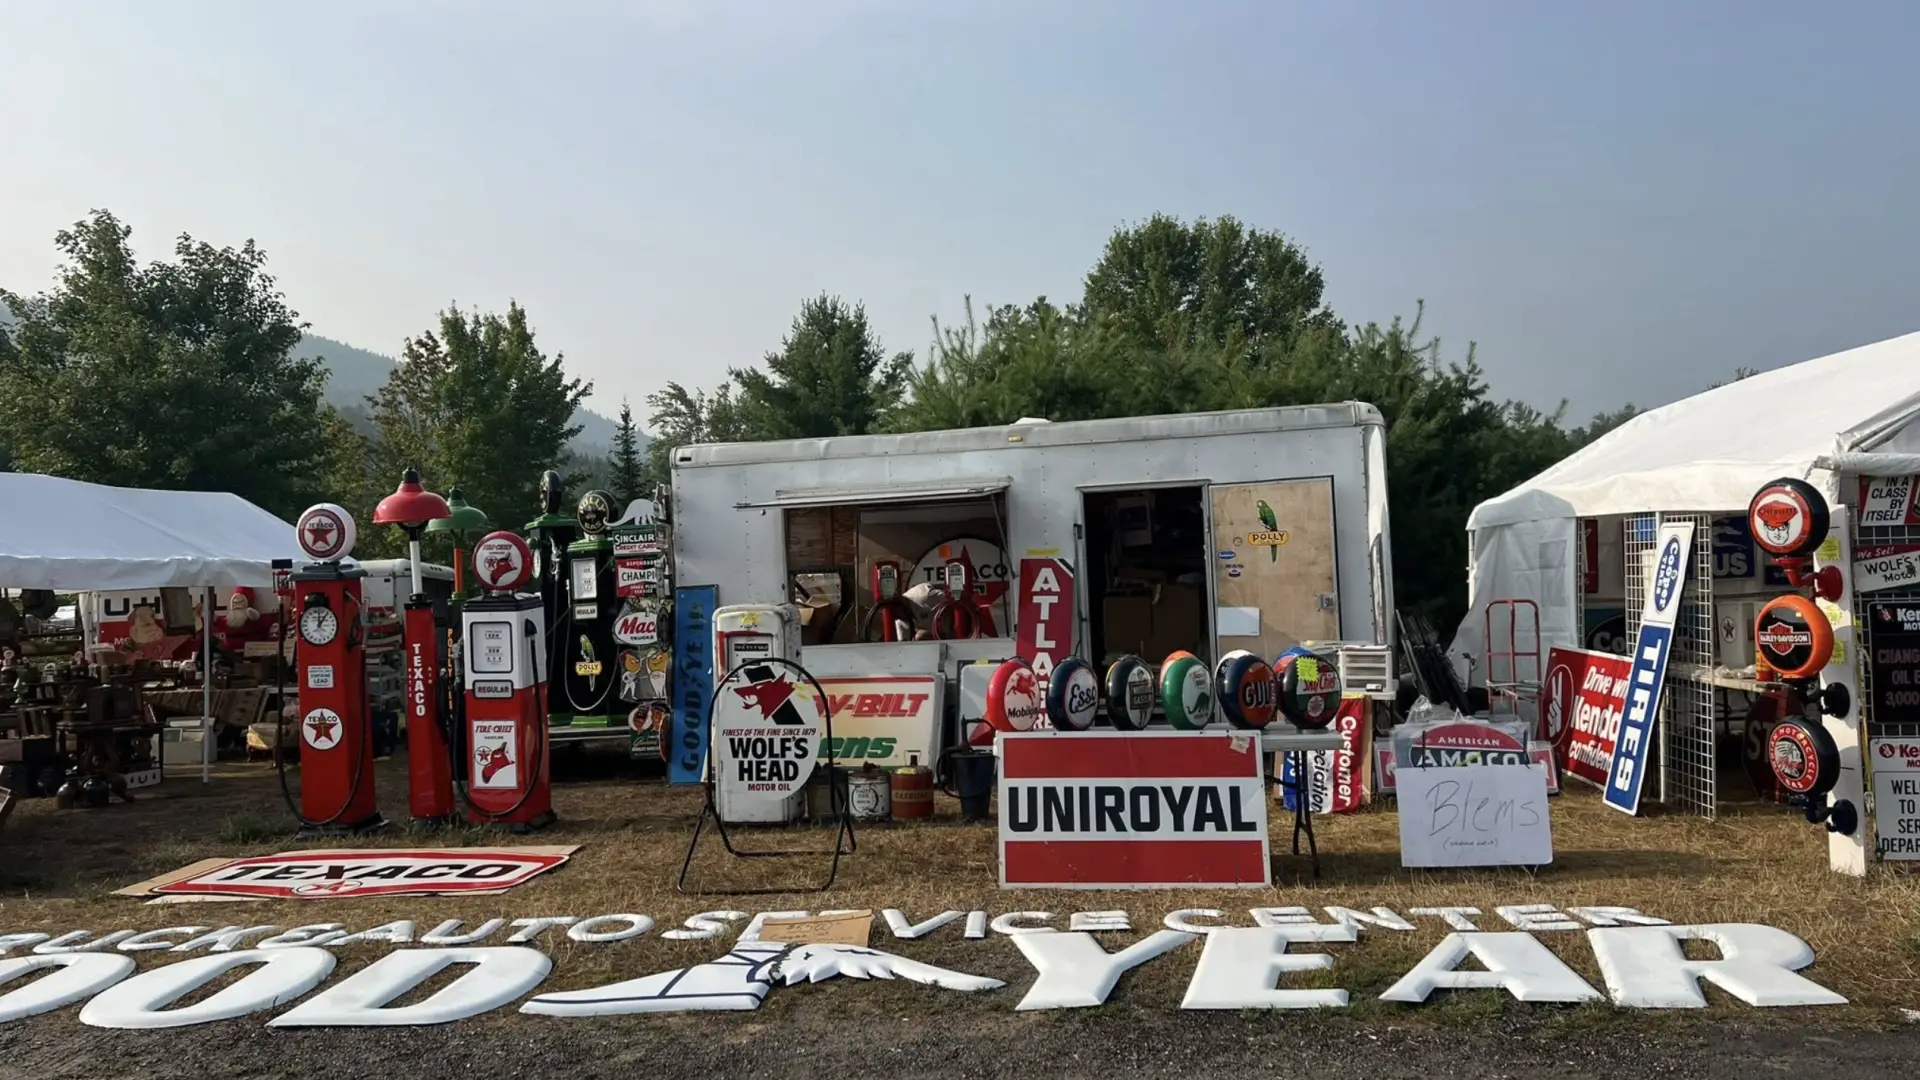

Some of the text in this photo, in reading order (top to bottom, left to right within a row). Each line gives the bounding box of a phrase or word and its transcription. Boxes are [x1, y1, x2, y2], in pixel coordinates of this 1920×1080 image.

[1871, 487, 1908, 499] CLASS
[1889, 499, 1905, 509] BY
[1866, 510, 1903, 520] ITSELF
[614, 533, 655, 545] SINCLAIR
[1252, 532, 1285, 542] POLLY
[1857, 546, 1895, 558] We Sell!
[923, 564, 1008, 582] TEACO
[1656, 556, 1667, 594] TIRES
[1660, 542, 1679, 608] Cooper
[1864, 556, 1912, 575] WOLF'S
[621, 571, 655, 581] CHAMPI
[1883, 570, 1917, 583] Motor
[618, 617, 656, 635] Mac
[412, 643, 425, 716] TEXACO
[681, 601, 704, 772] GOODYEAR
[1582, 665, 1613, 696] Drive
[1892, 670, 1911, 685] OIL
[1069, 683, 1097, 712] Esso
[1570, 695, 1621, 741] Kenda
[1614, 638, 1662, 792] TIRES
[475, 725, 513, 733] FIRE-CHIEF
[722, 728, 743, 736] FINEST
[766, 728, 782, 736] FINE
[729, 736, 809, 759] WOLF'S
[1438, 736, 1500, 746] AMERICAN
[1338, 715, 1357, 807] Customer
[1778, 727, 1816, 780] MOTORCYCLE
[738, 760, 799, 781] HEAD
[748, 783, 791, 791] MOTOR OIL
[1311, 750, 1329, 813] eciation
[1008, 786, 1257, 832] UNIROYAL
[1425, 780, 1540, 837] Blems
[1899, 800, 1915, 814] TO
[217, 863, 522, 882] TEXACO
[325, 913, 654, 945] AUTO
[660, 909, 1131, 941] SEVICE
[1164, 904, 1672, 934] CENTER
[1008, 922, 1849, 1010] YEAR
